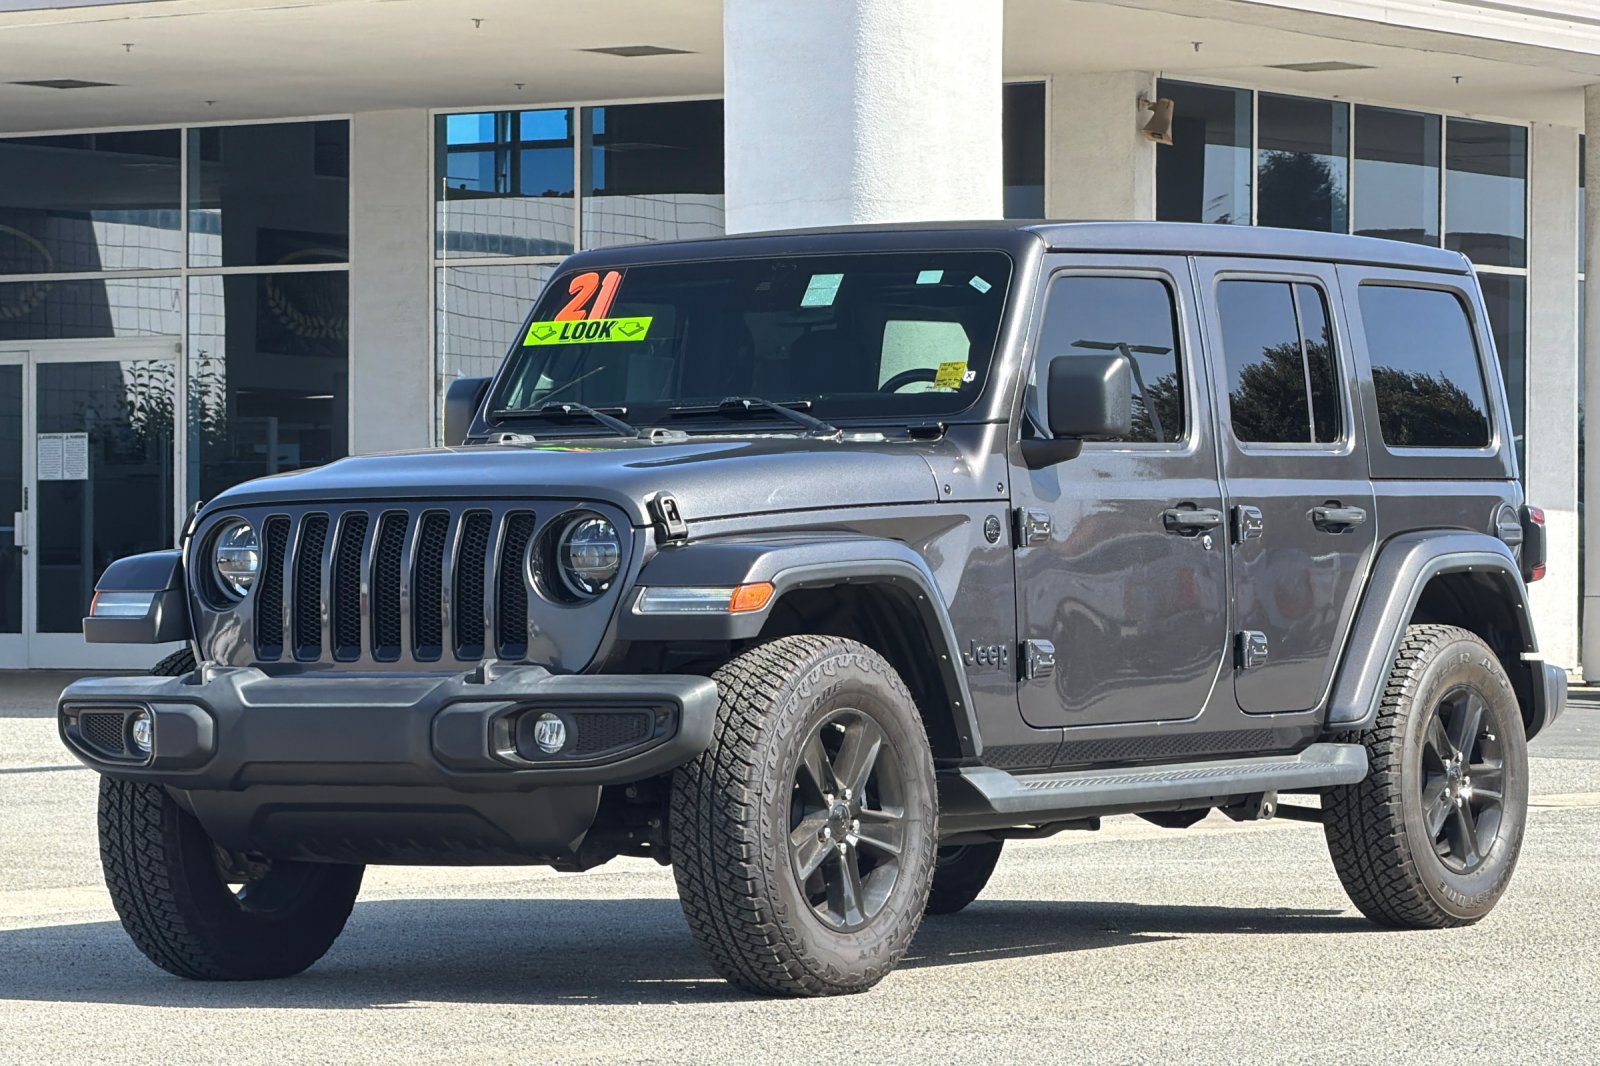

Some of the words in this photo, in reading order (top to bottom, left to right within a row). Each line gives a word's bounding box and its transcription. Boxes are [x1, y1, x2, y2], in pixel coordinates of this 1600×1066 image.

[553, 271, 621, 322] 21
[559, 321, 619, 342] LOOK
[963, 639, 1008, 670] Jeep
